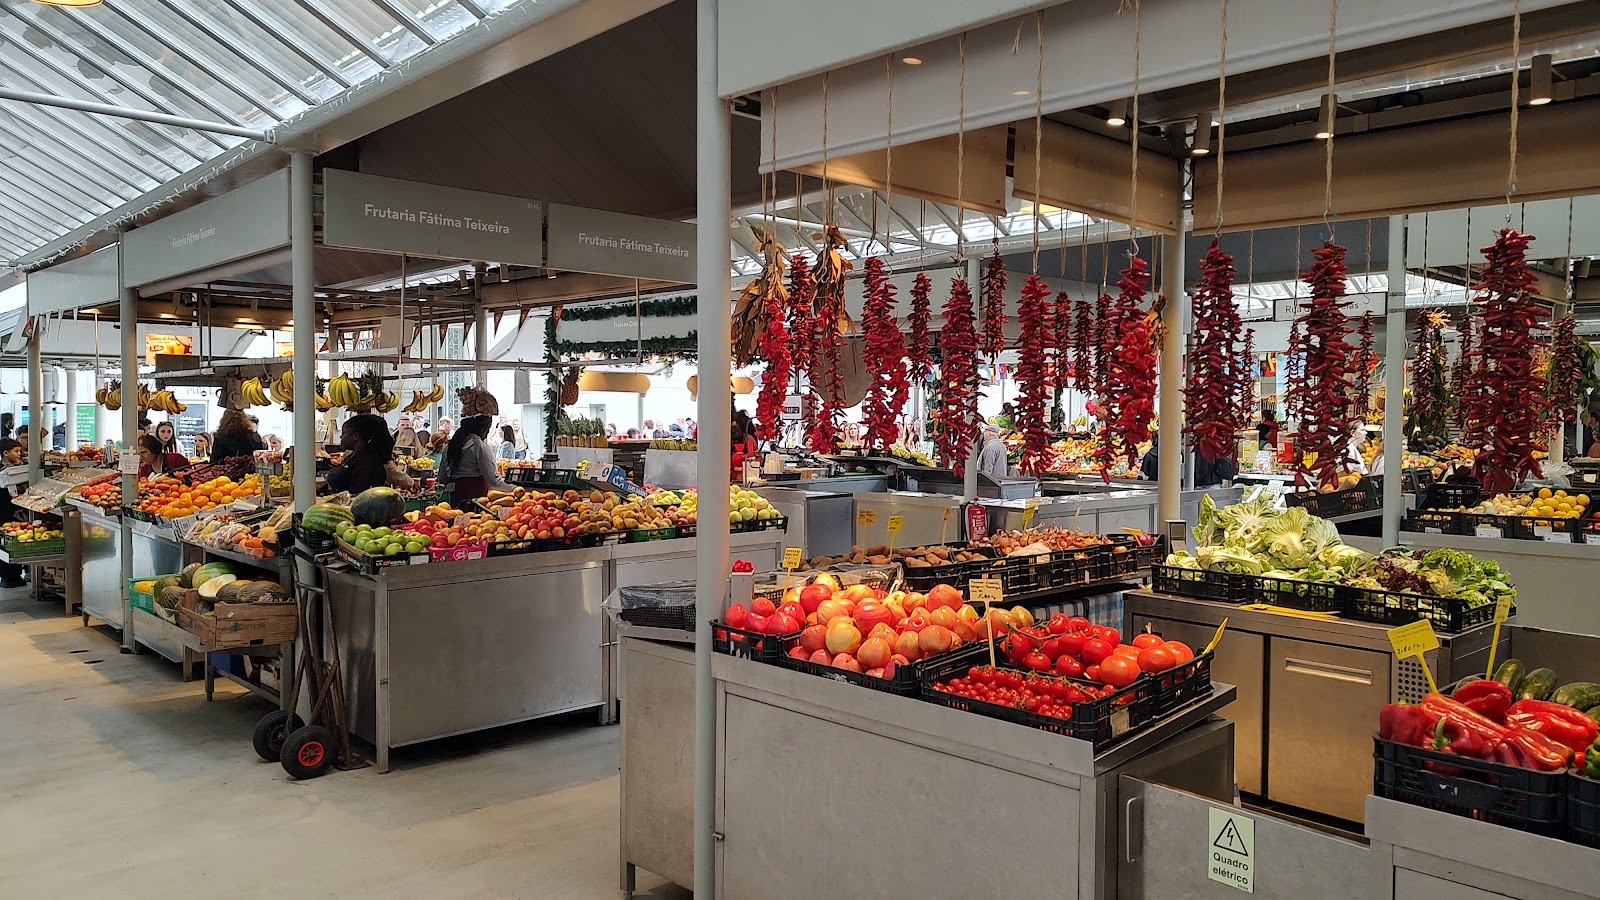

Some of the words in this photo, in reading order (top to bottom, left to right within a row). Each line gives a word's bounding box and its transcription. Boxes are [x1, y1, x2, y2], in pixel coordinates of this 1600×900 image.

[364, 203, 416, 223] Frutaria
[419, 210, 462, 228] Fátima
[463, 216, 510, 235] Teixeira
[578, 232, 618, 248] Frutaria
[620, 238, 652, 253] Fátima
[654, 242, 689, 258] Teixeira
[1213, 852, 1249, 871] Quadro
[1212, 866, 1249, 885] elétrico
